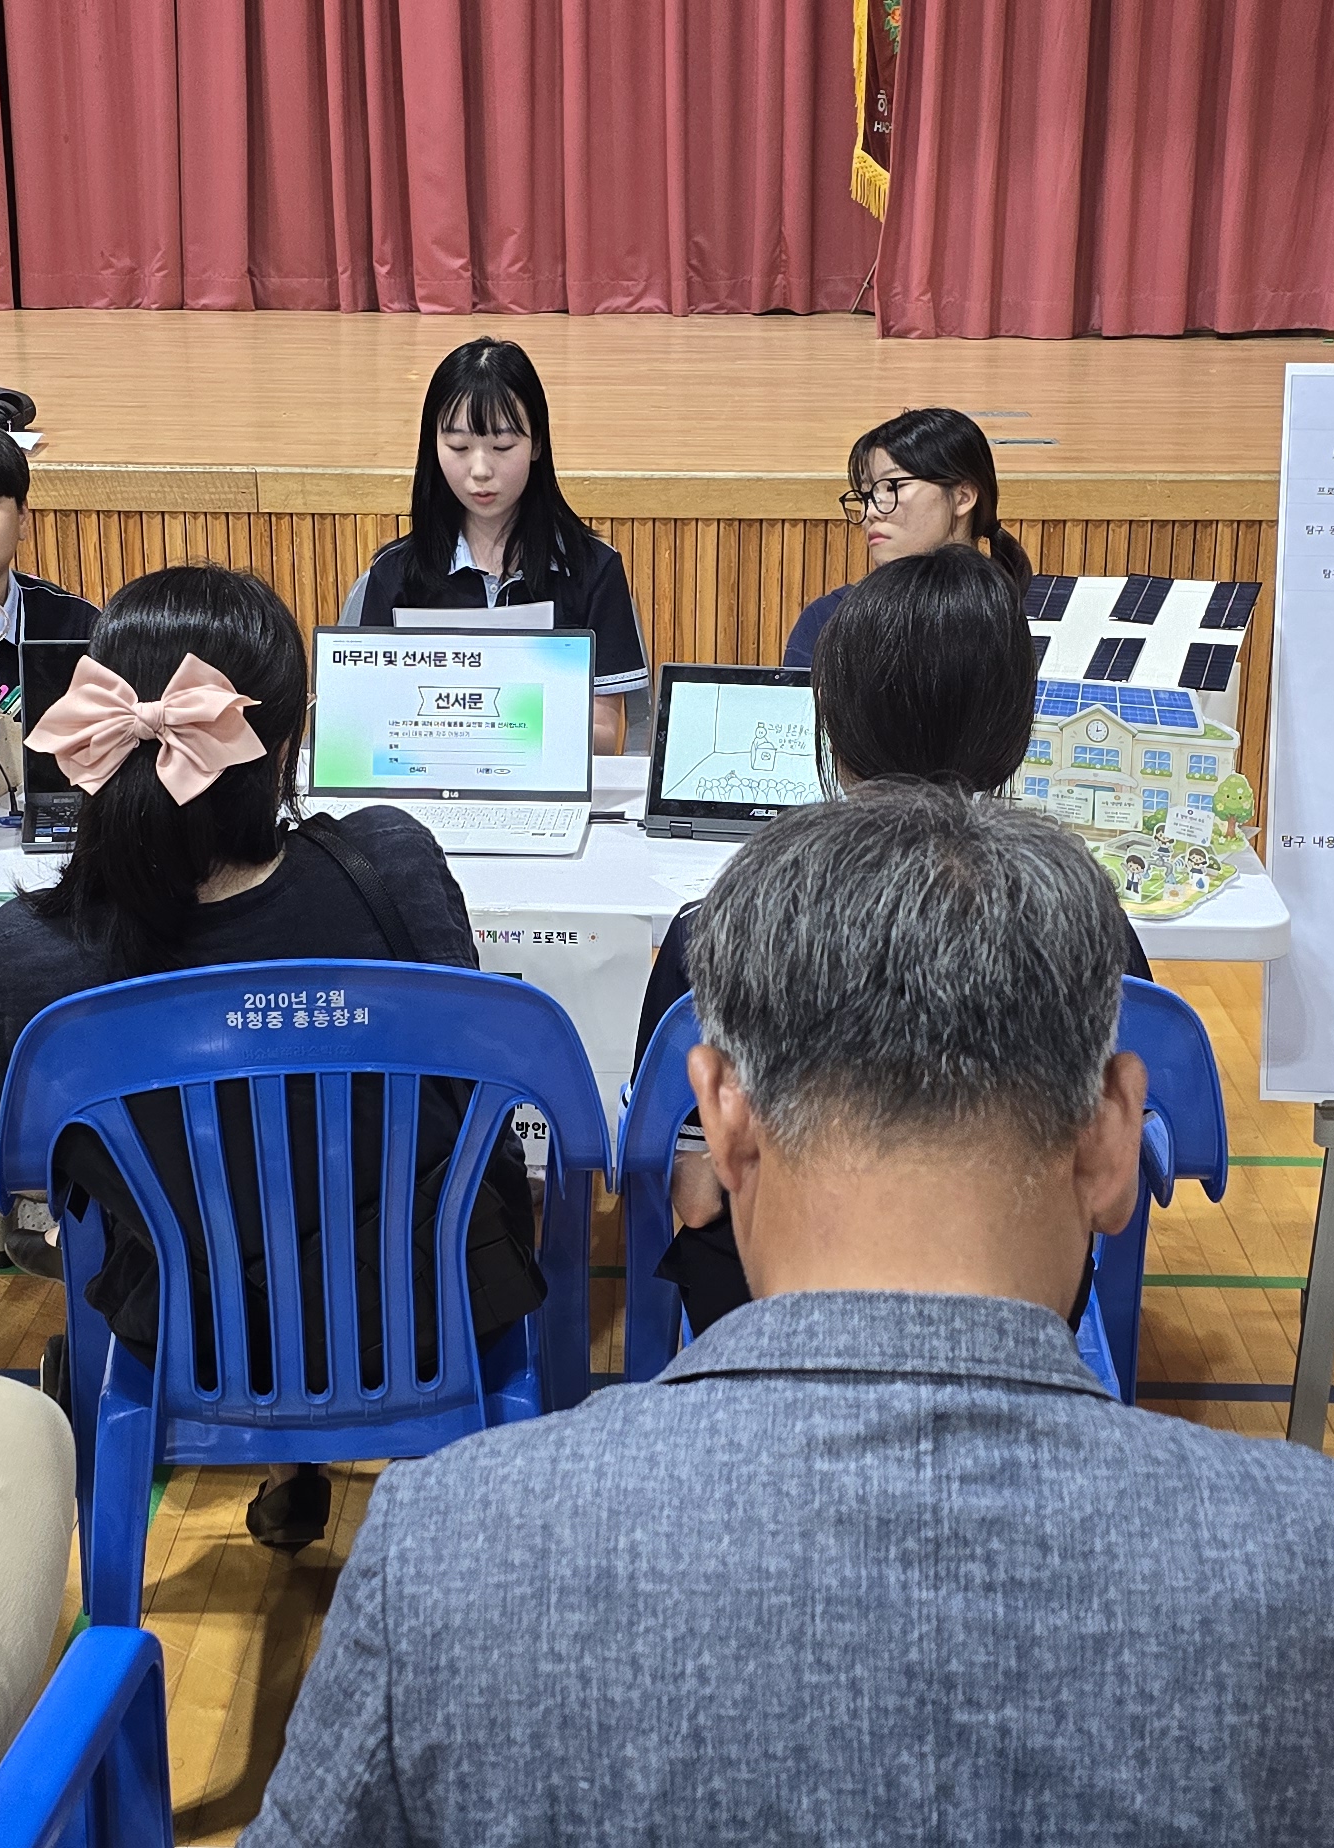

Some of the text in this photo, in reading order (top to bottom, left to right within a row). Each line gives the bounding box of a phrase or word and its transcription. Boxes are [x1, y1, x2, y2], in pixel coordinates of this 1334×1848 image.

[1305, 524, 1325, 536] 탐구
[332, 649, 482, 668] 마무리 및 선서문 작성
[434, 692, 484, 710] 선서문
[1281, 834, 1307, 849] 탐구
[532, 931, 579, 945] 프로젝트
[243, 989, 345, 1009] 2010년 2월
[225, 1006, 369, 1030] 하청중 총동창회
[515, 1121, 548, 1140] 방안
